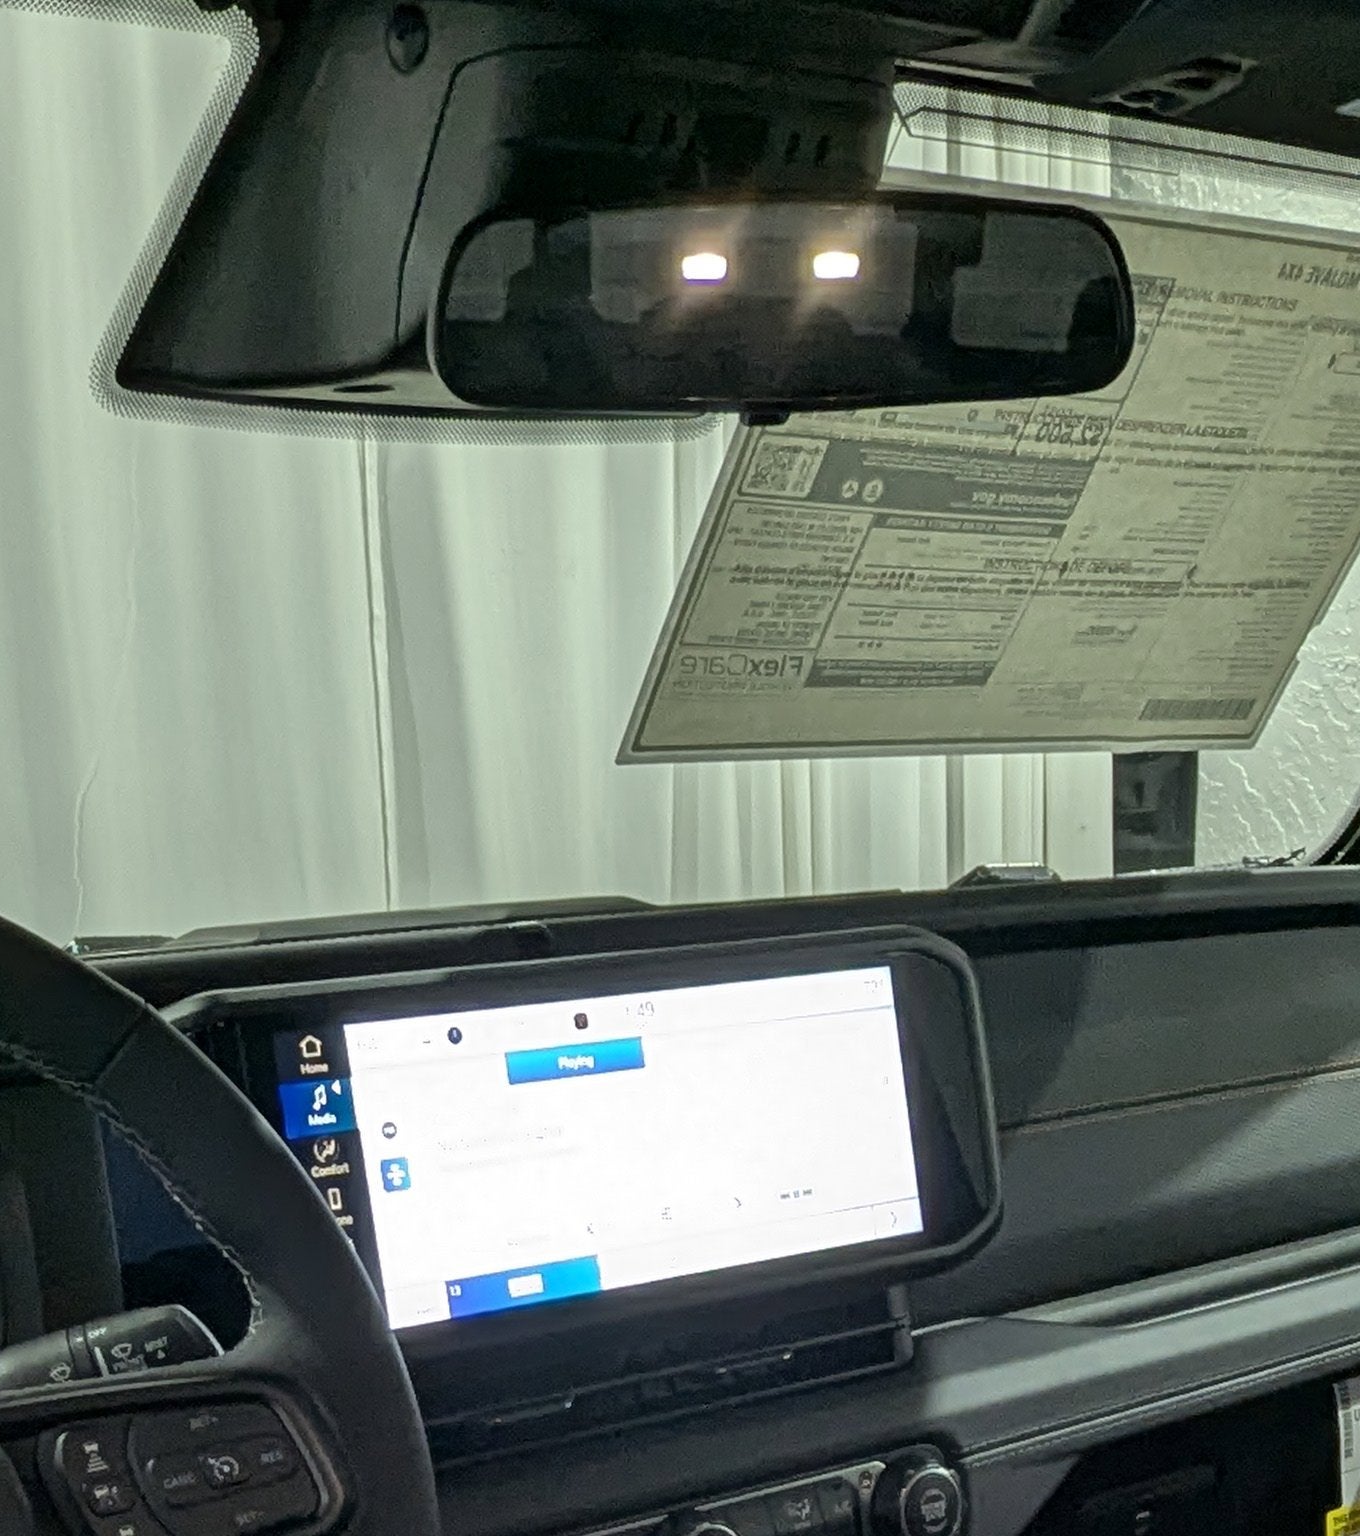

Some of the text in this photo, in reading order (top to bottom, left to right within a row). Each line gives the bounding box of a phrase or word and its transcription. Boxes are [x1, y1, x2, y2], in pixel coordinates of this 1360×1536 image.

[300, 1062, 329, 1074] Home
[308, 1112, 337, 1126] Media
[311, 1162, 350, 1178] Comfort
